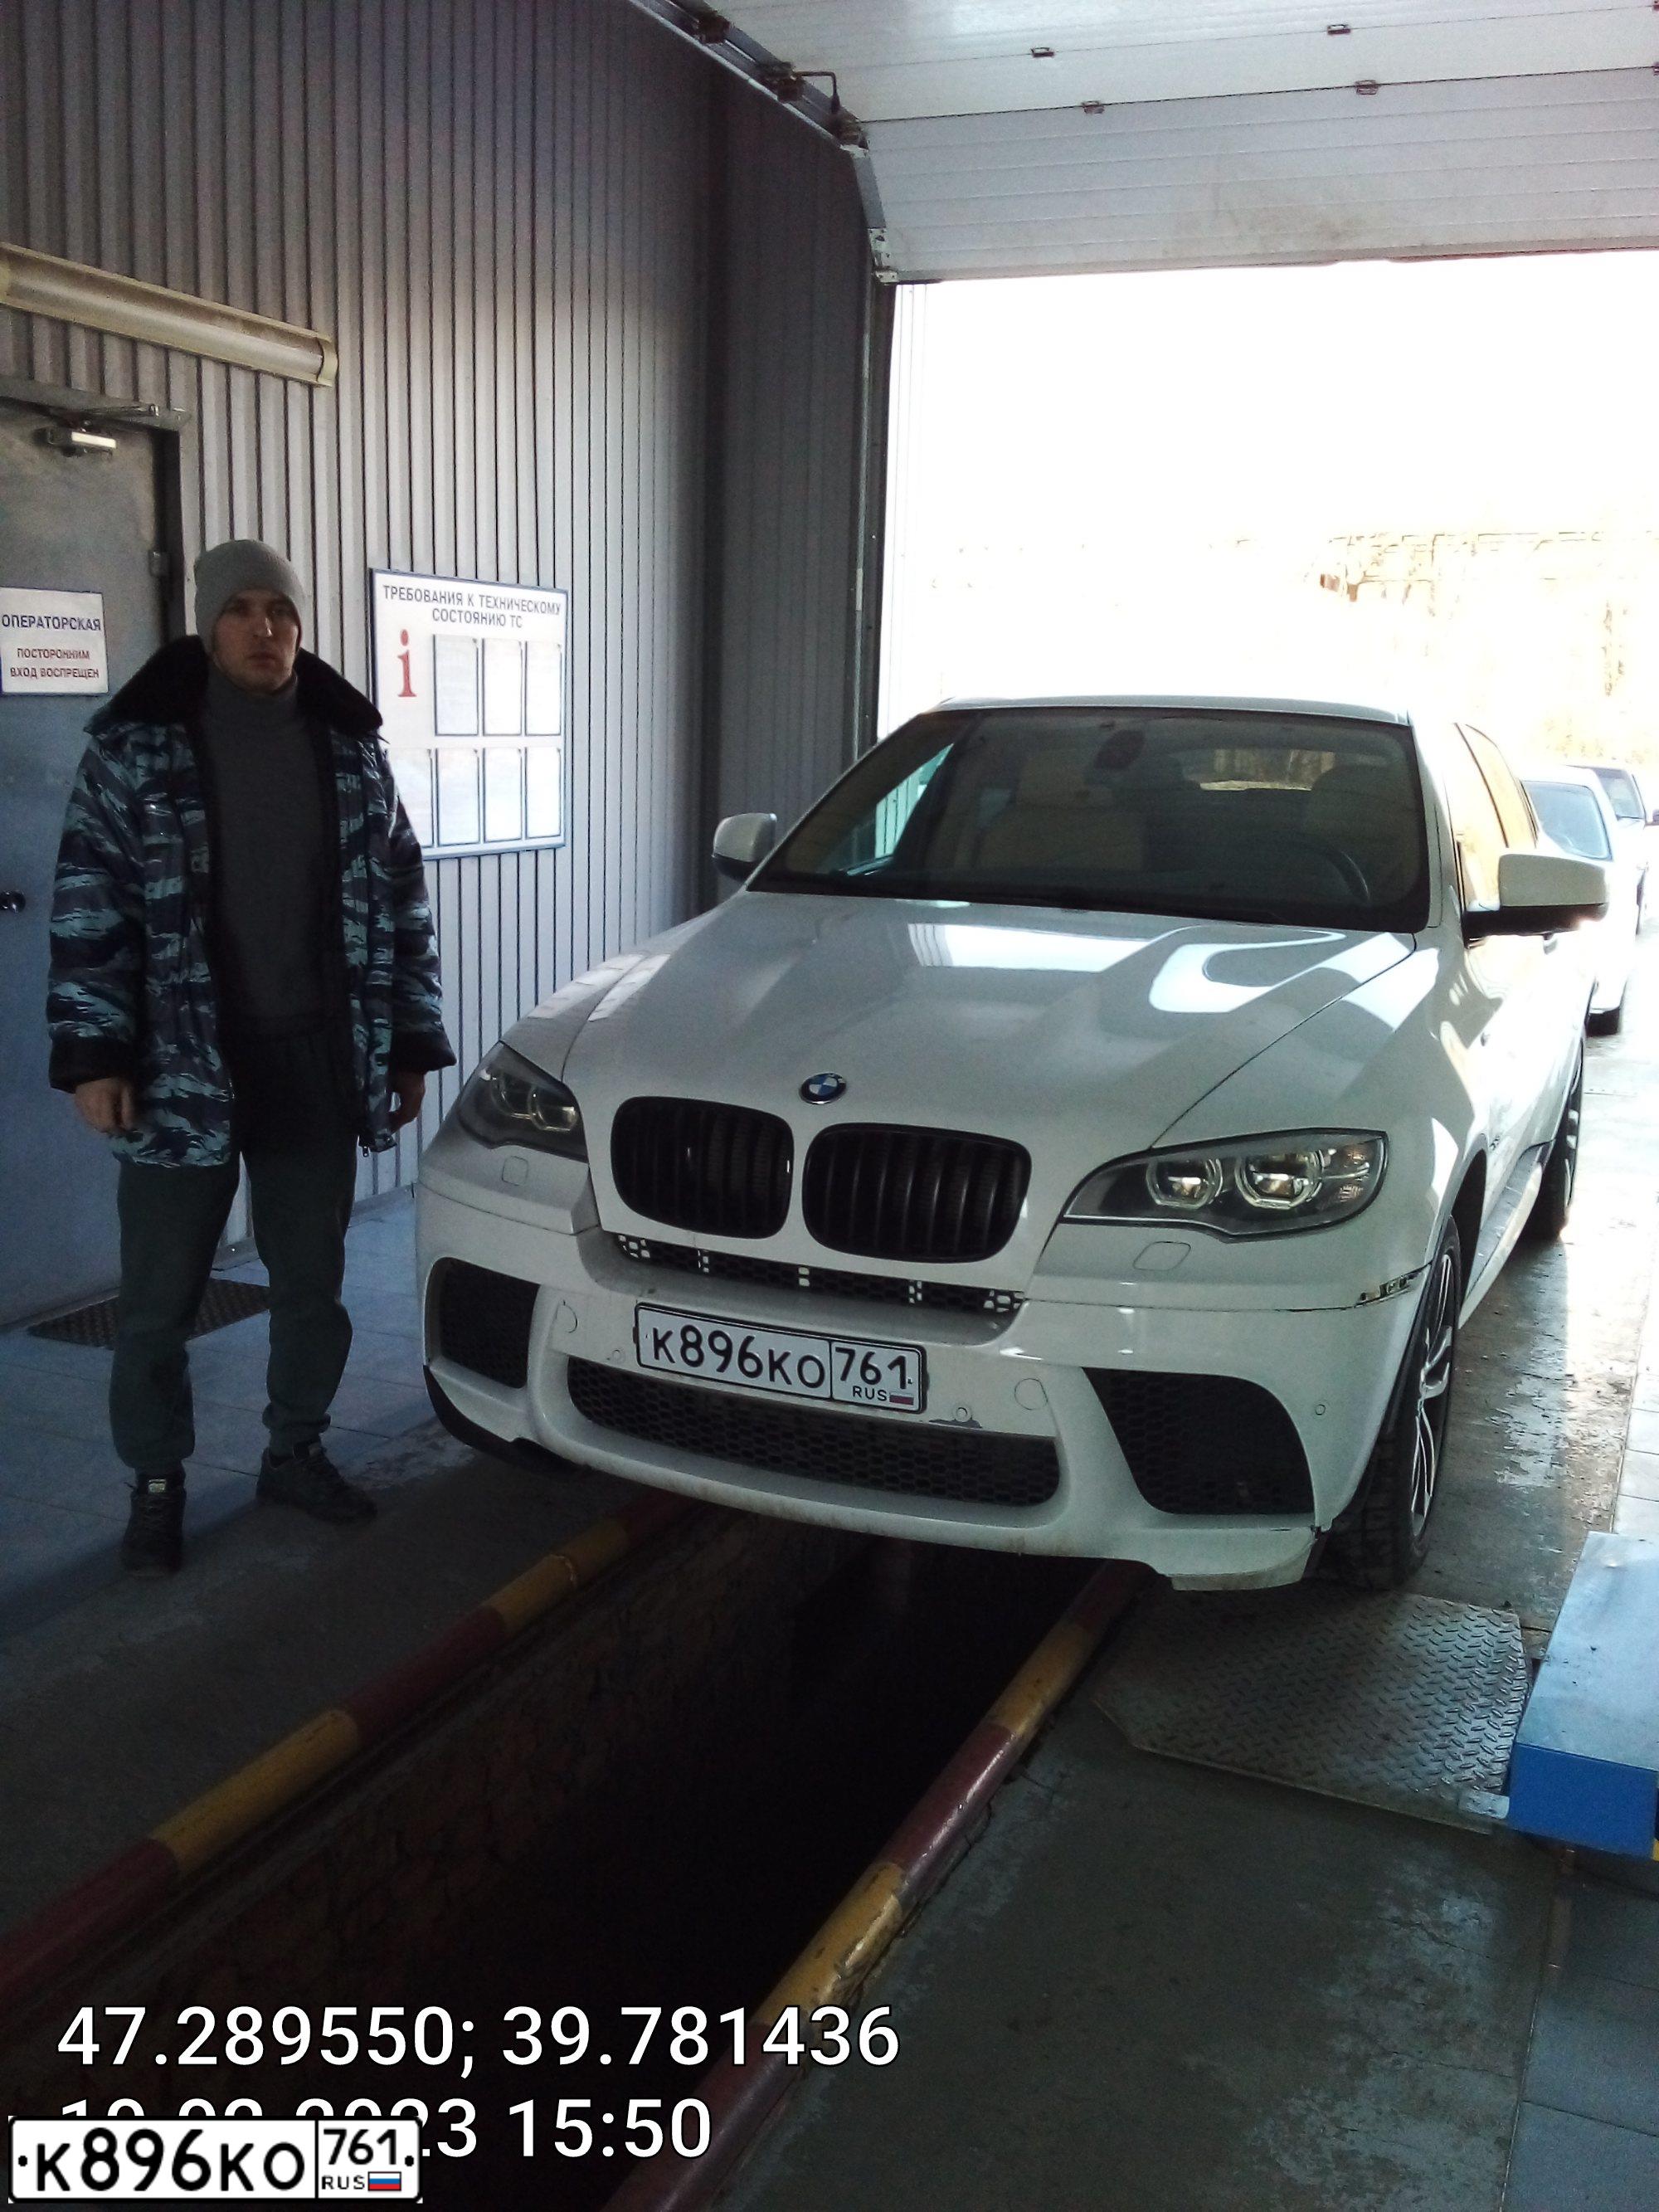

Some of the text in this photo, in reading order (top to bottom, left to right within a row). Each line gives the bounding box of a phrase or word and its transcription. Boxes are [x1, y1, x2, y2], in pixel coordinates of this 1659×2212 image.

[383, 585, 561, 616] ТРЕБОВАНИЯ К ТЕХНИЧЕСКОМУ
[2, 614, 101, 631] ОПЕРАТОРСКАЯ
[432, 608, 523, 628] СОСТОЯНИЮ ТС
[17, 648, 90, 660] ПОСТОРОННИМ
[10, 667, 100, 680] ВХОД ВОСПРЕЩЕН
[834, 1346, 907, 1391] 761
[852, 1385, 888, 1402] RUS
